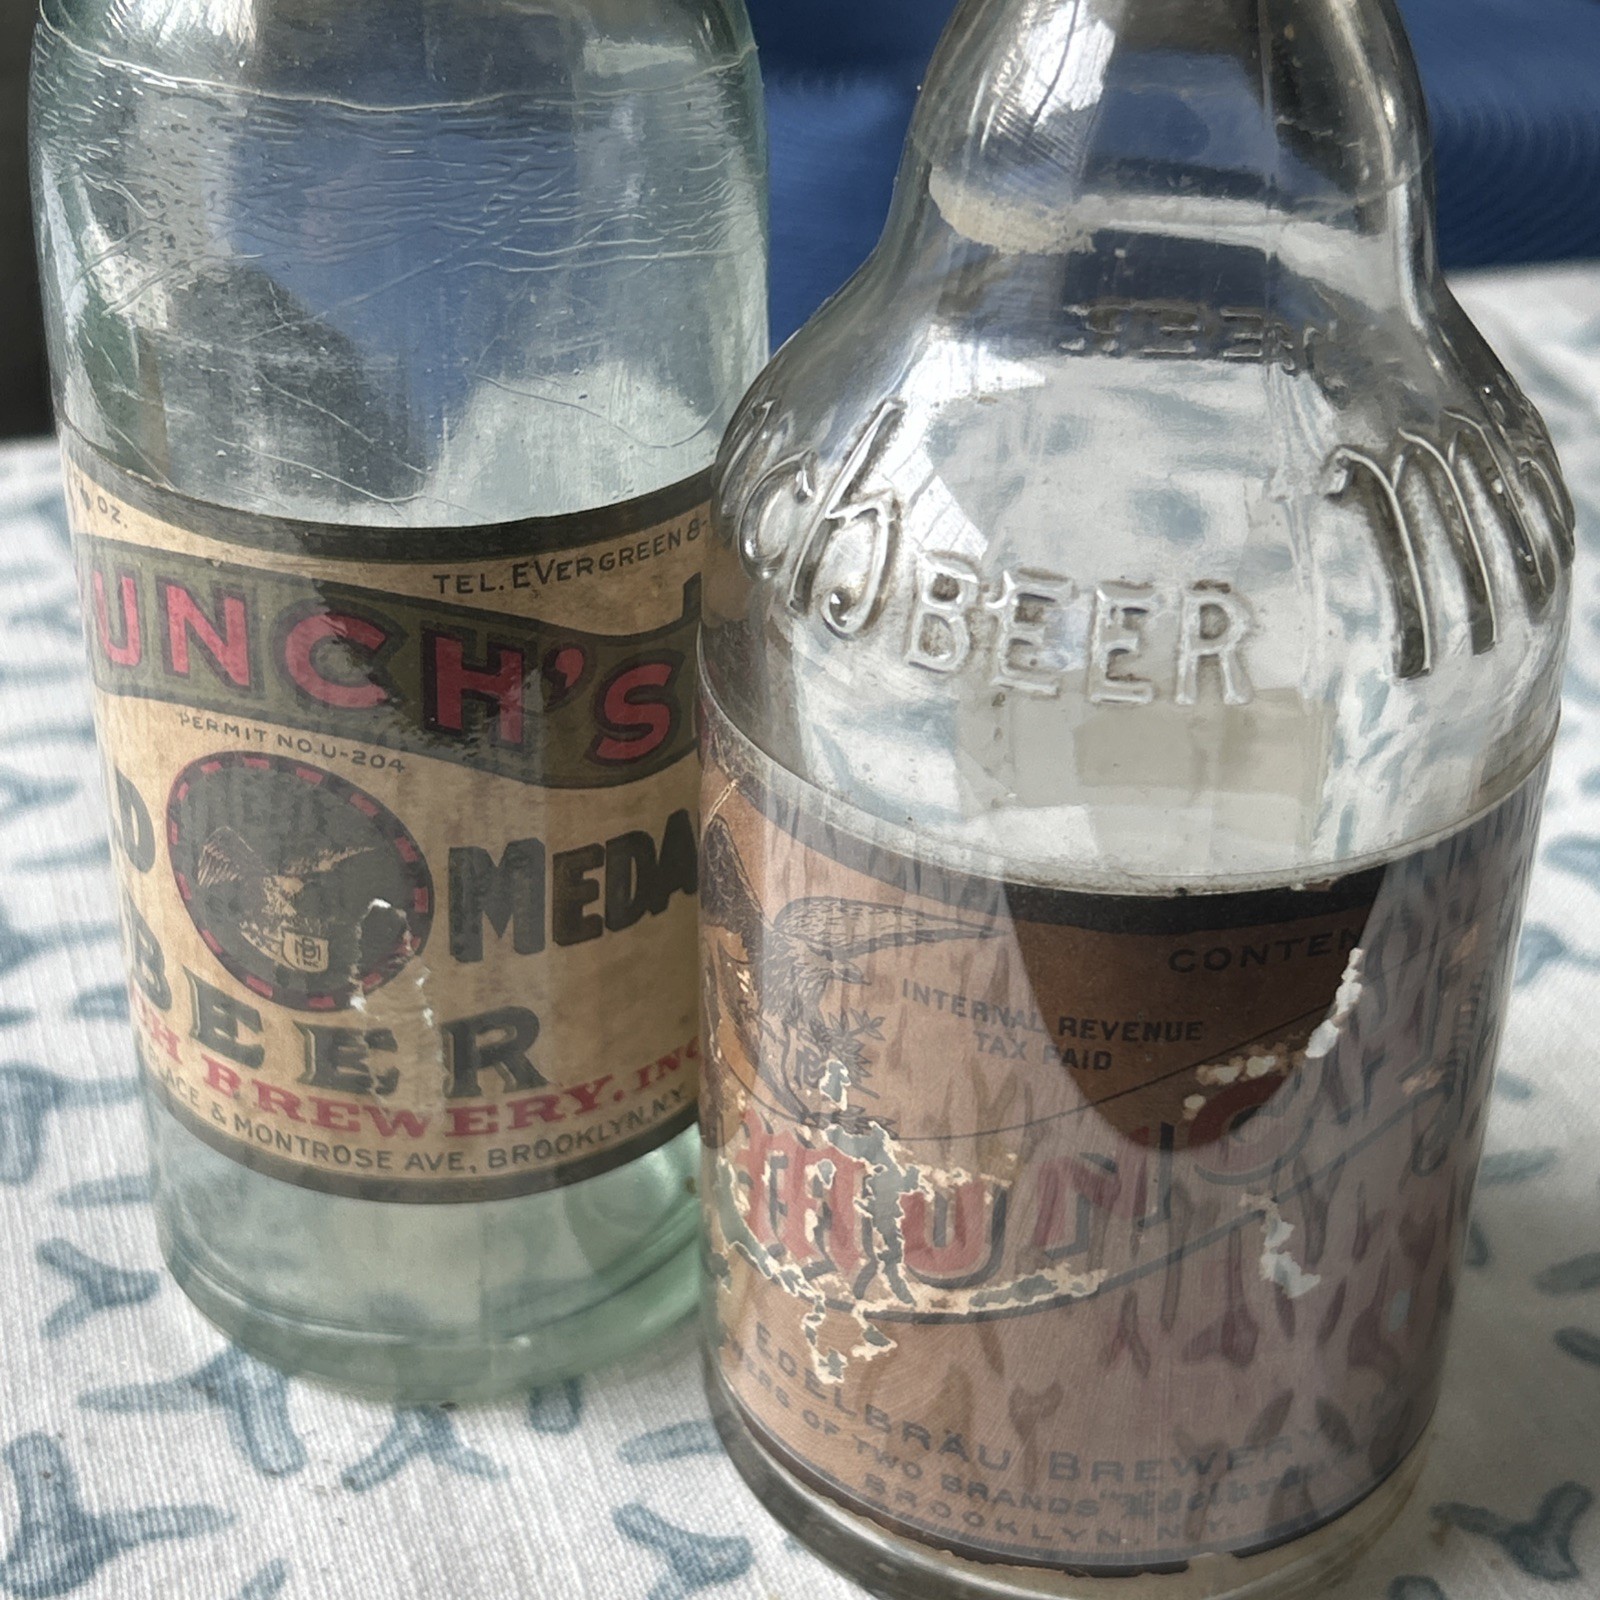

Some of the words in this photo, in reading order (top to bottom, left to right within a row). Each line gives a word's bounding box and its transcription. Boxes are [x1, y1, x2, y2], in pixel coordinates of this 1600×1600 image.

[433, 572, 505, 595] TEL.
[511, 524, 682, 590] EVERGREEN
[904, 548, 1256, 706] BEER
[178, 711, 268, 743] PERMIT
[130, 894, 552, 1097] BEER
[903, 978, 1047, 1034] INTERNAL
[1058, 1015, 1204, 1042] REVENUE
[972, 1030, 1028, 1061] TAX
[1042, 1047, 1113, 1071] PAID
[211, 1102, 227, 1125] &
[233, 1112, 392, 1170] MONTROSE
[803, 1409, 841, 1436] OF
[851, 1433, 923, 1481] TWO
[941, 1472, 1097, 1517] BRANDS
